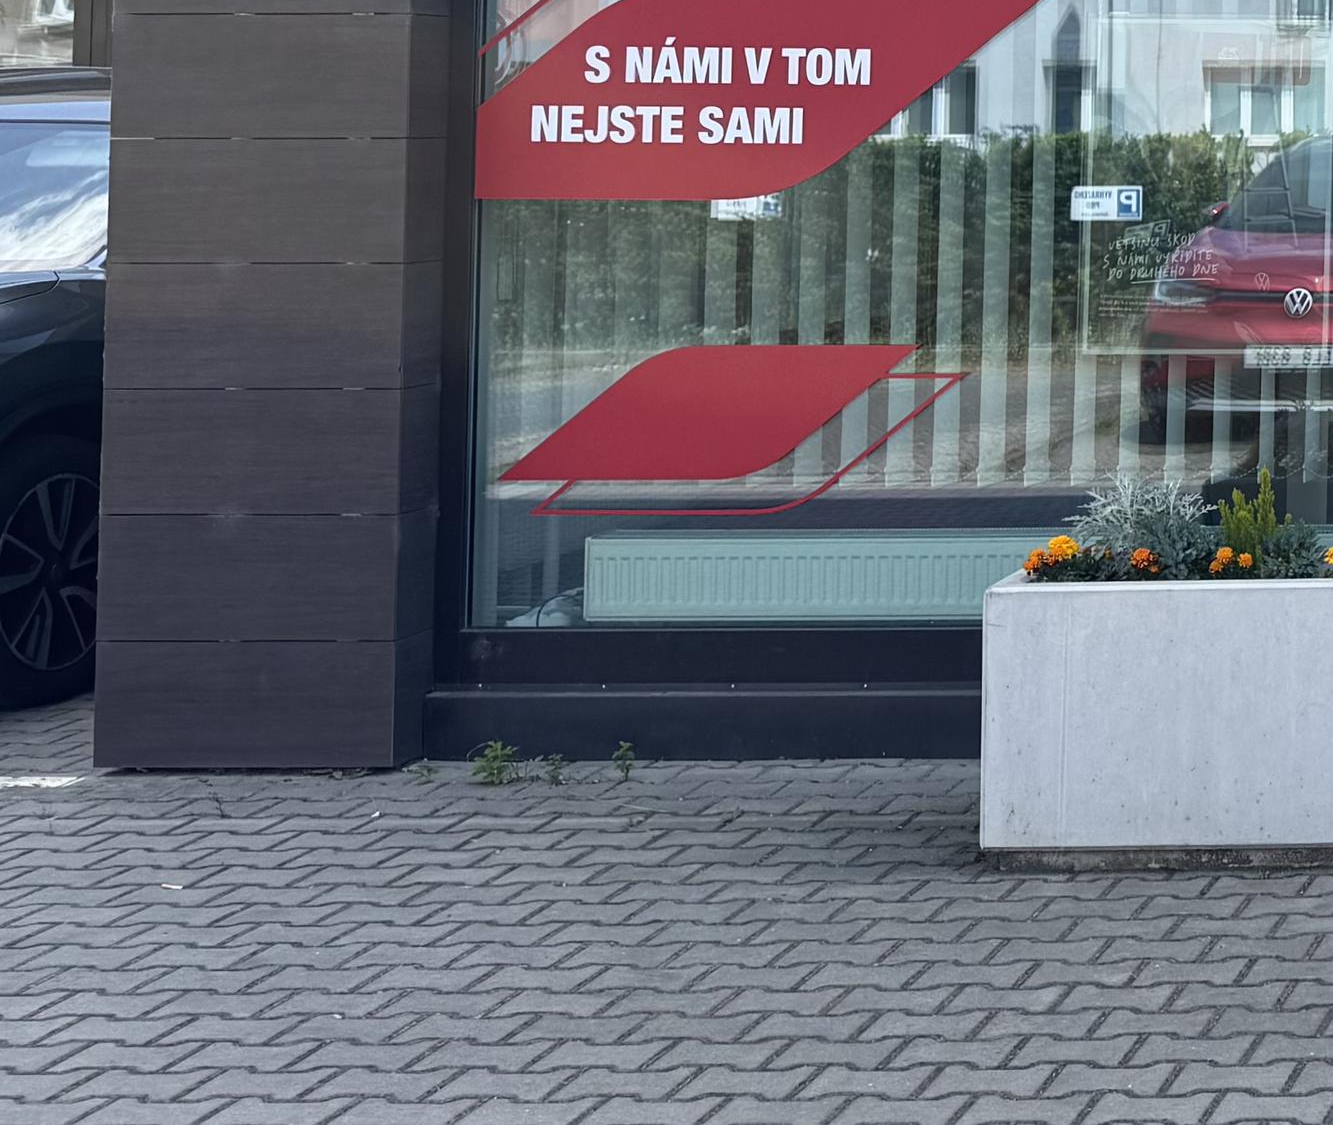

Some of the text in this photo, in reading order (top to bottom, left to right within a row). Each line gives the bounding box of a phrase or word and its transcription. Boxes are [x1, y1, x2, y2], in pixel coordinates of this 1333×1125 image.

[584, 37, 872, 85] S NÁMI V TOM
[531, 105, 804, 145] NEJSTE SAMI
[1192, 263, 1219, 277] DNE
